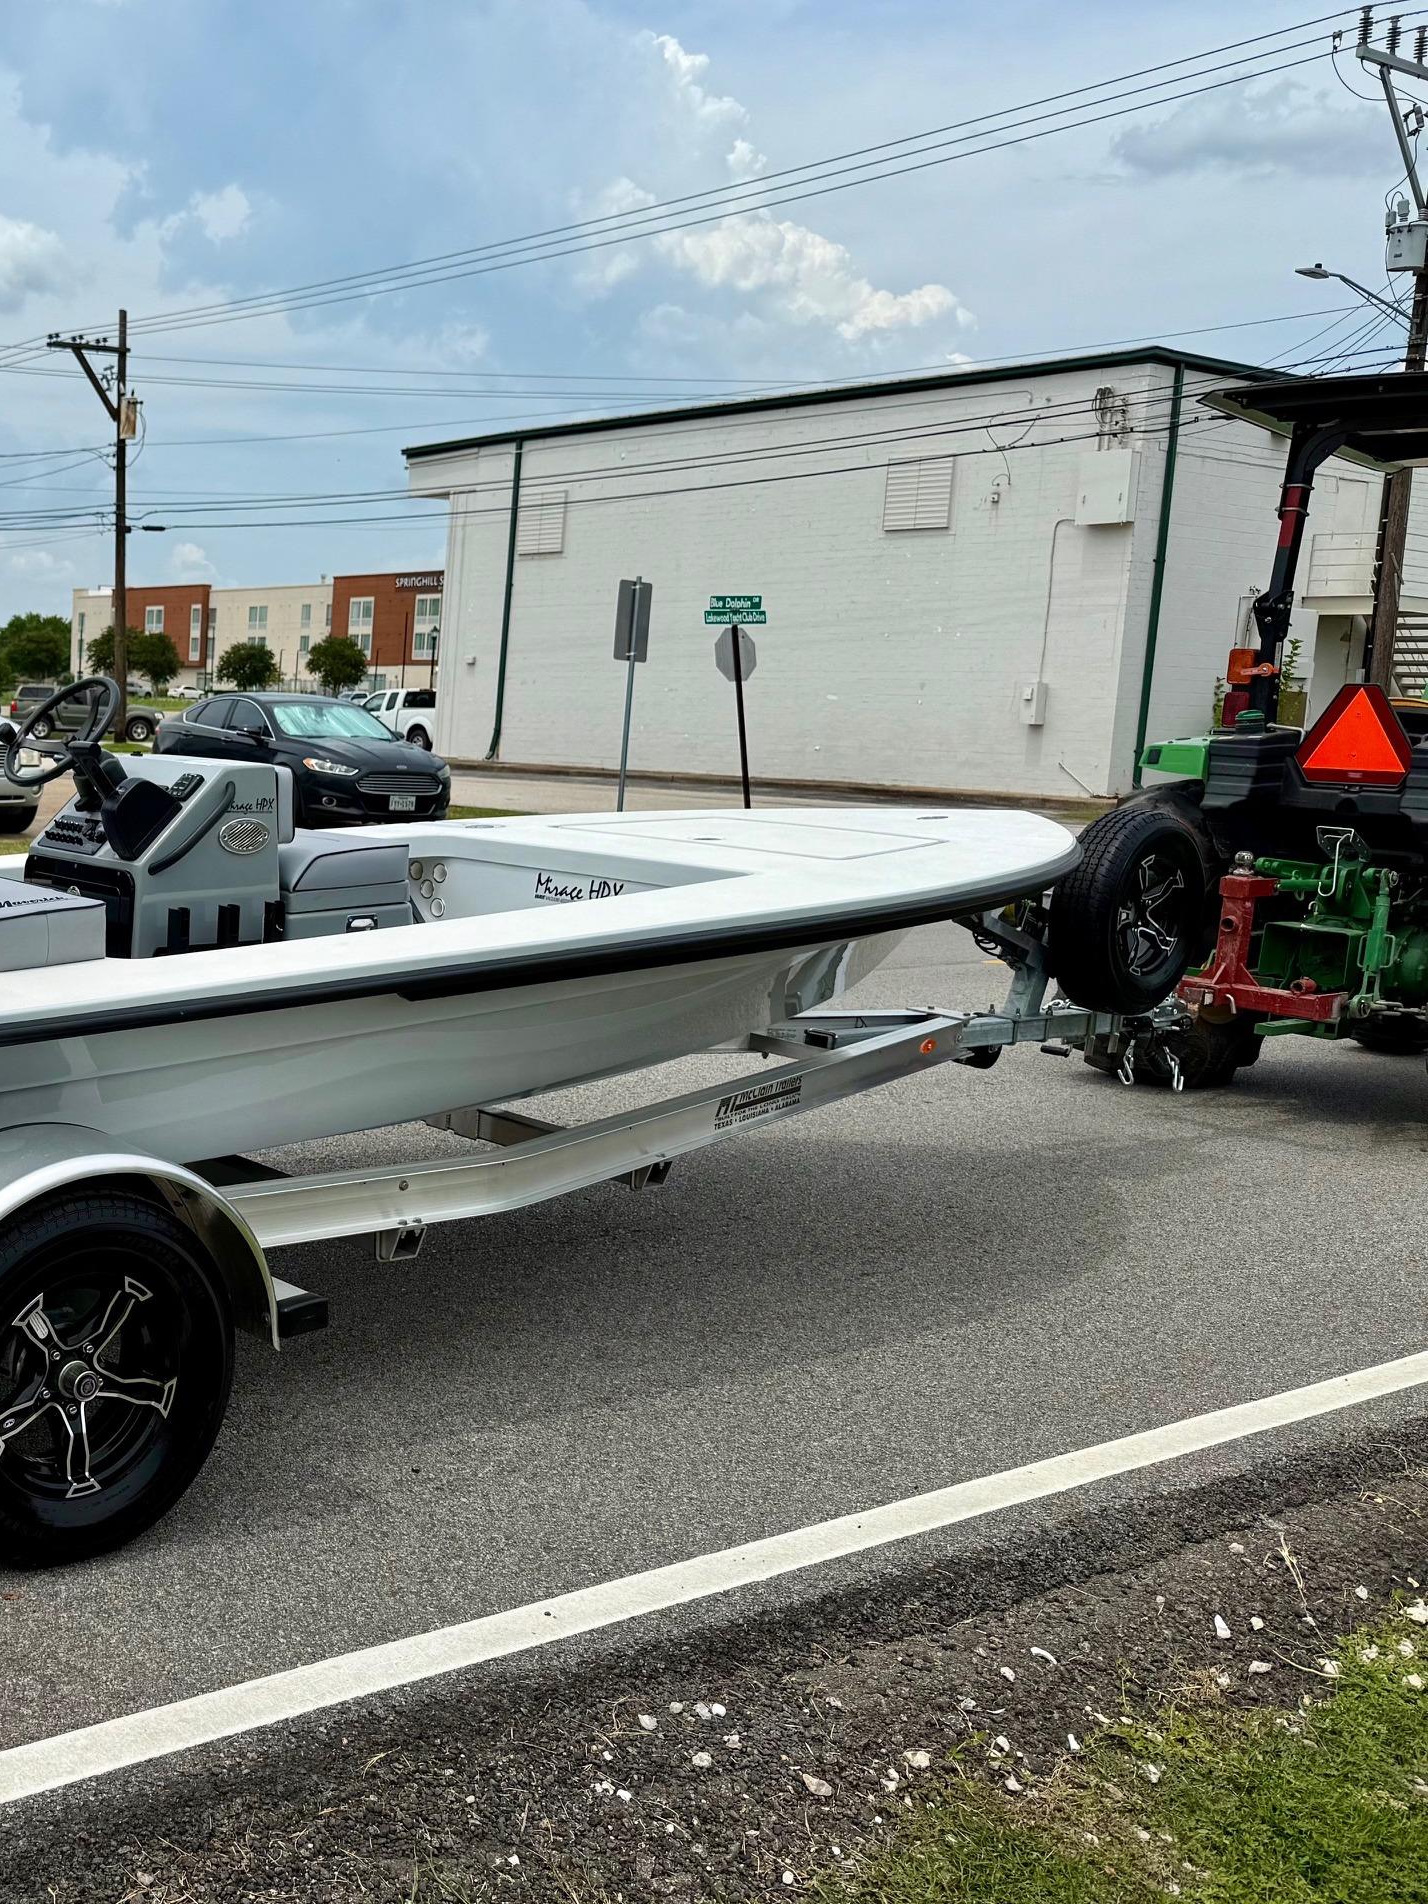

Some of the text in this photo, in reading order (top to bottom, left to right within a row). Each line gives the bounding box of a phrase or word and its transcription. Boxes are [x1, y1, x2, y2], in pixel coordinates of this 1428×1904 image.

[395, 576, 438, 588] SPRINGHILL
[710, 598, 723, 608] Blue
[725, 597, 751, 608] Dolphin
[229, 797, 275, 815] irage HPX
[714, 1097, 800, 1130] TEXAS LOUISIANA ALABAMA
